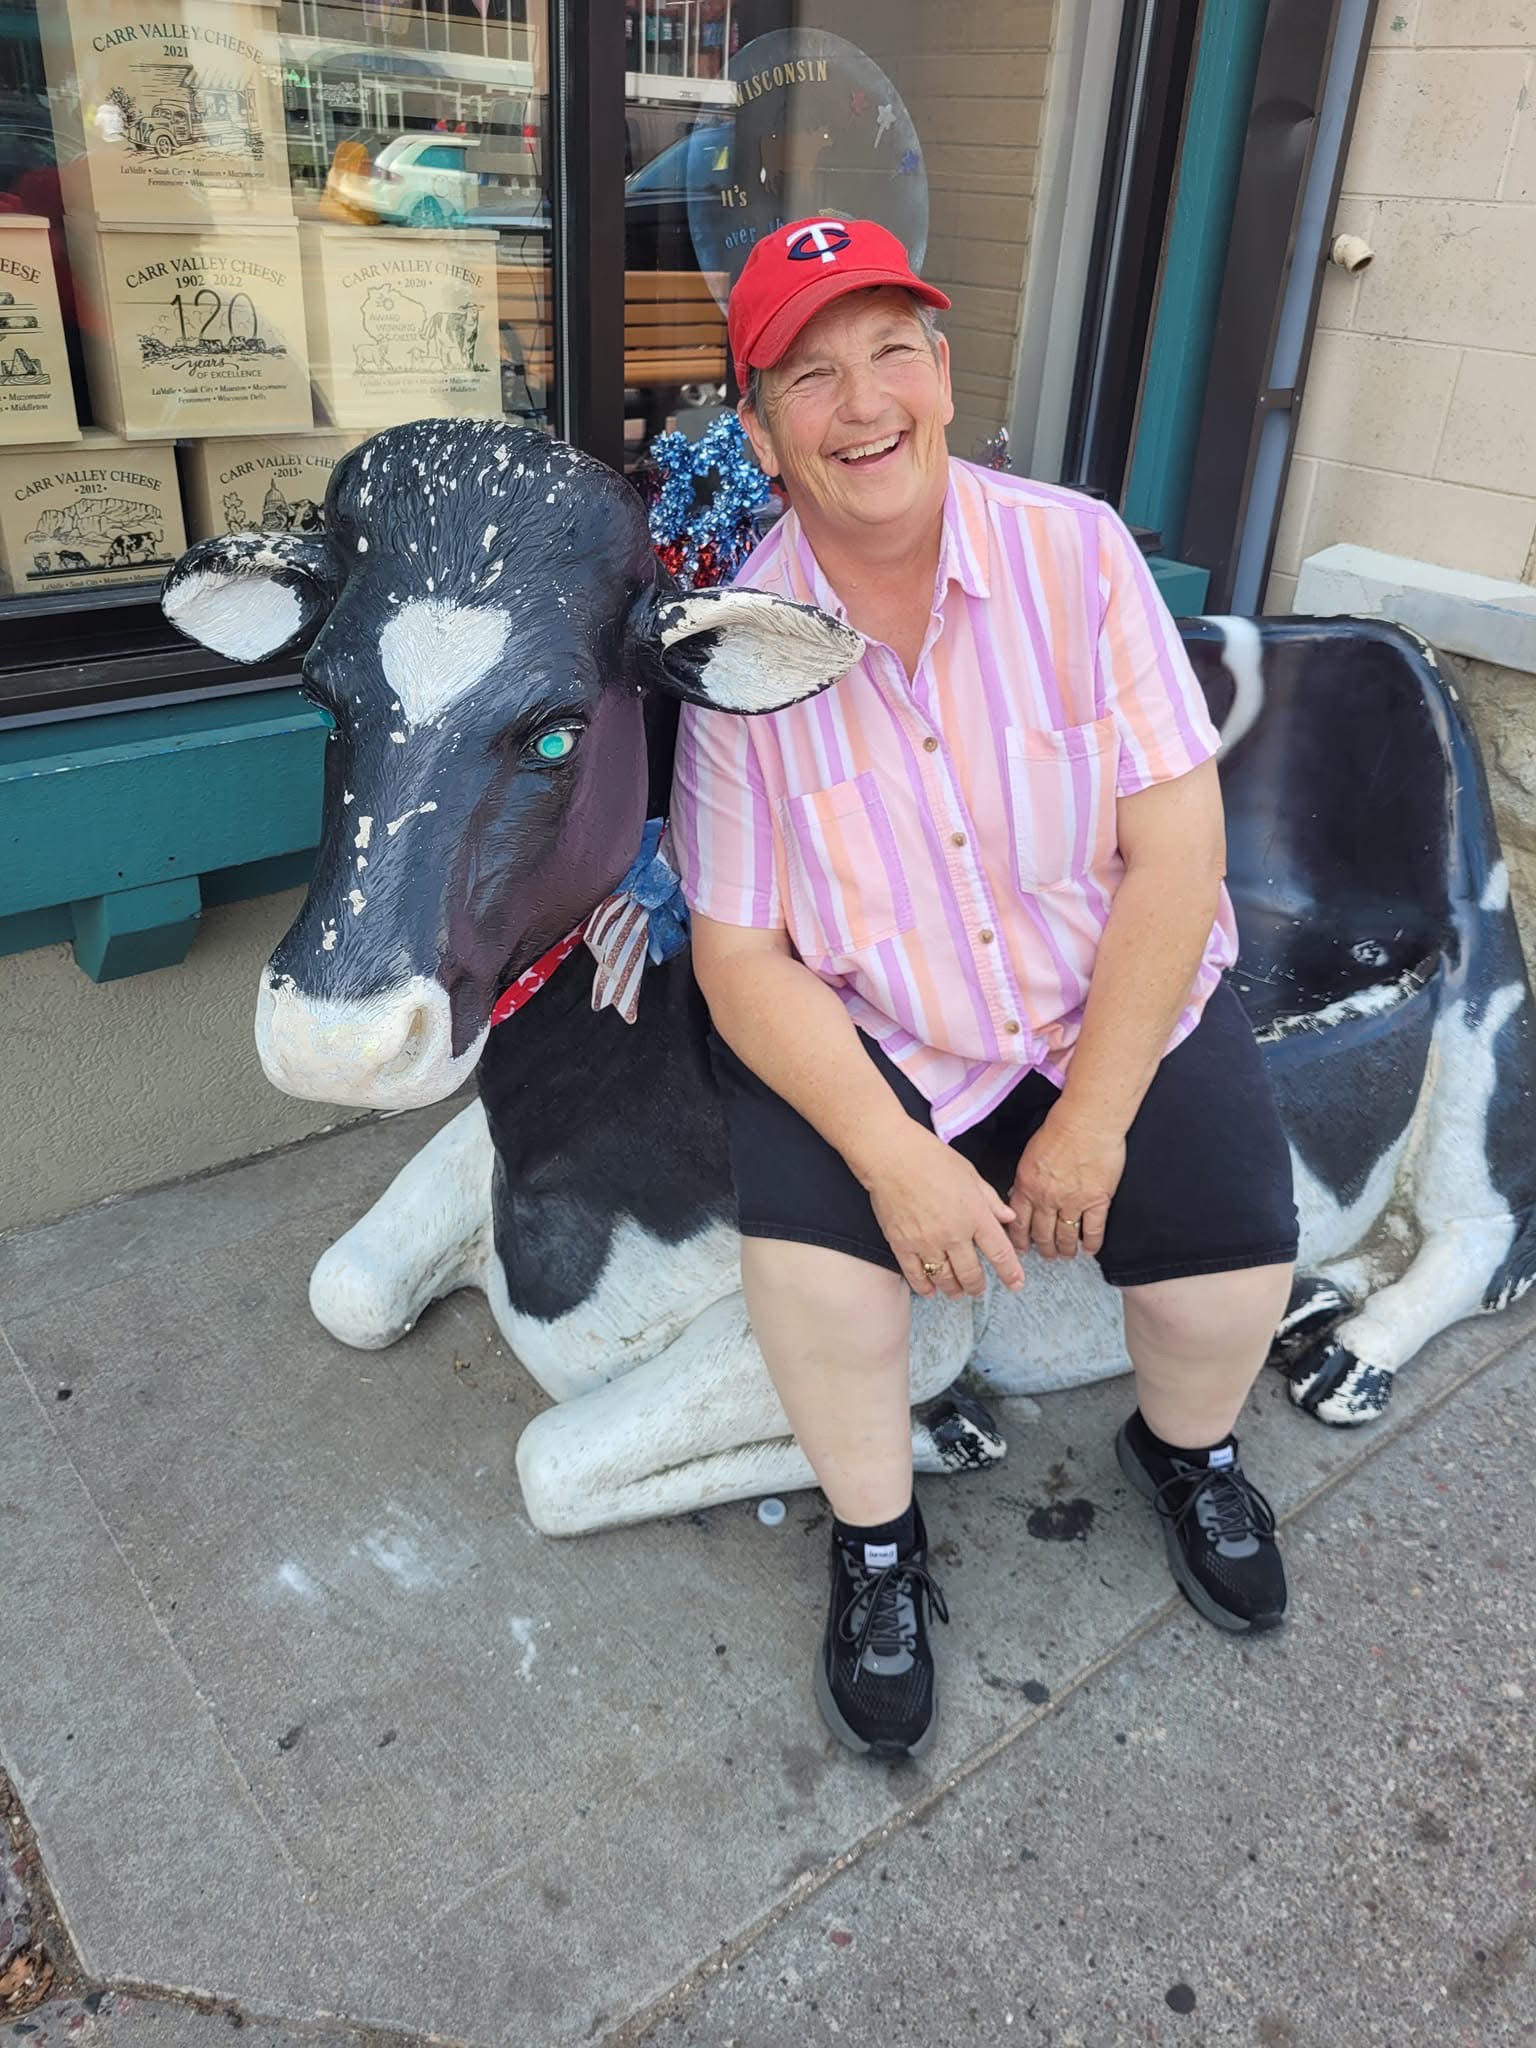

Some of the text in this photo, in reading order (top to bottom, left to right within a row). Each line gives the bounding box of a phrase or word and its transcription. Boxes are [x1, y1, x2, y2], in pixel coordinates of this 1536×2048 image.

[93, 23, 264, 64] CARR VALLEY CHEESE
[163, 45, 189, 58] 2021
[729, 59, 828, 107] WISCONSIN
[725, 225, 757, 249] over
[126, 256, 287, 289] CARR VALLEY CHEESE
[176, 273, 244, 289] 1902 2022
[342, 259, 485, 289] CARR VALLEY CHEESE
[404, 278, 427, 289] 2020
[170, 288, 258, 340] 120
[171, 357, 240, 376] years
[197, 369, 263, 379] OF EXCELLENCE
[220, 461, 256, 485] CARR
[256, 454, 303, 469] VALLEY
[276, 468, 298, 478] 2013
[15, 469, 162, 501] CARR VALLEY CHEESE
[79, 484, 102, 495] 2012
